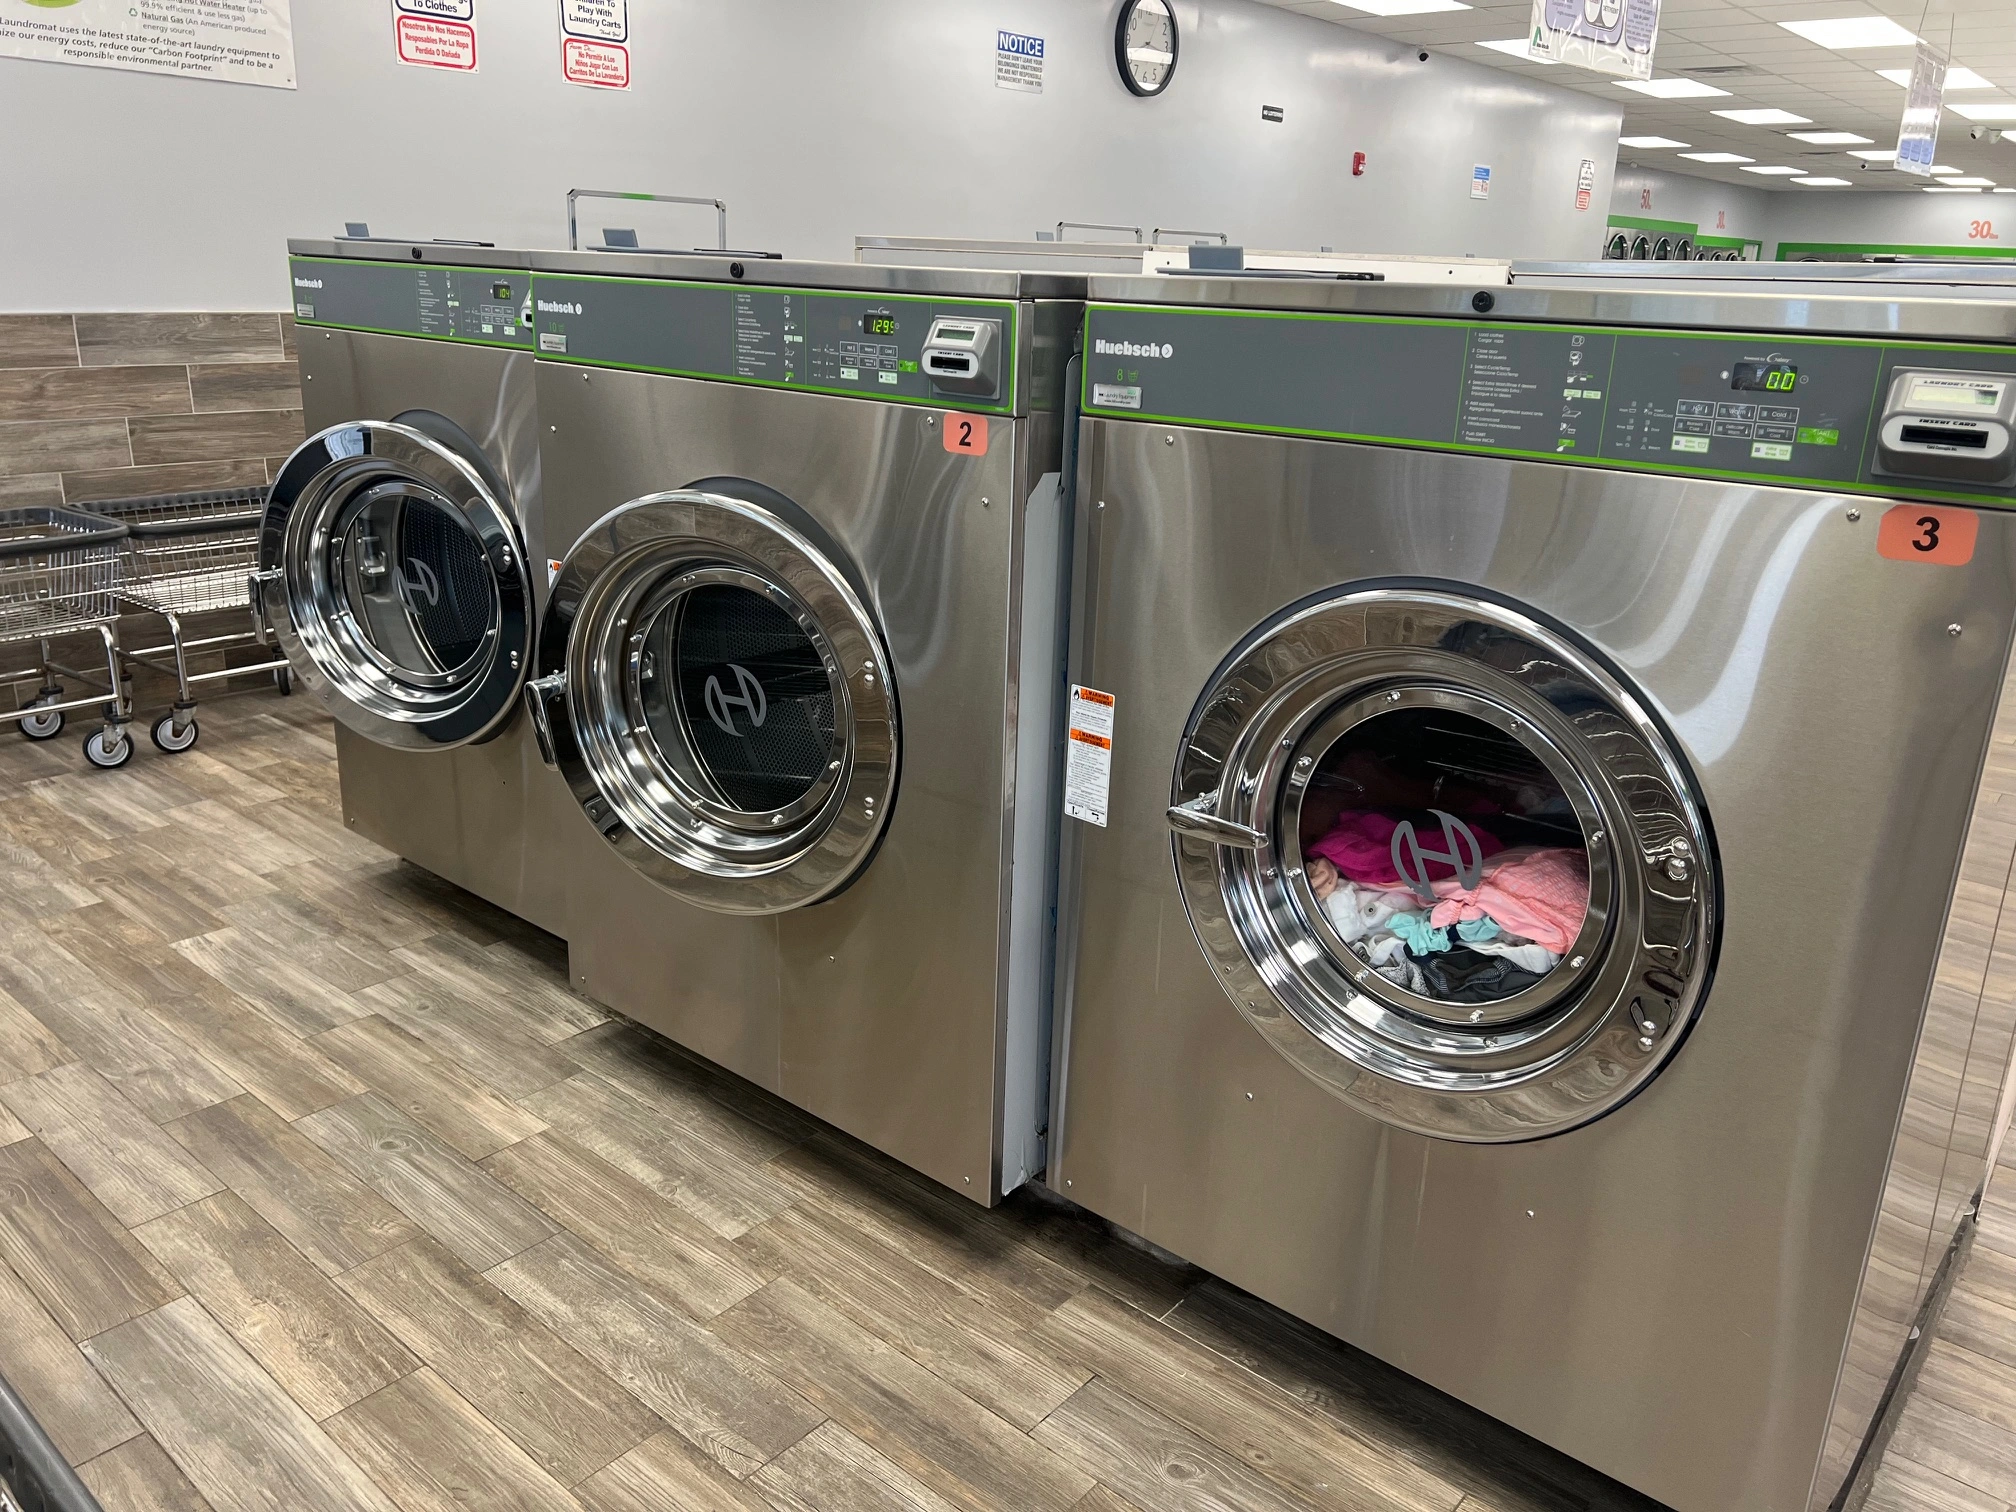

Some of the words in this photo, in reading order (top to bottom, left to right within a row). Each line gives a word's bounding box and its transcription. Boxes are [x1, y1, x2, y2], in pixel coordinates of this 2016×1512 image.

[200, 0, 220, 8] Water
[222, 2, 245, 11] Heater
[247, 5, 258, 13] (up
[425, 0, 458, 13] Clothes
[577, 4, 594, 16] Play
[594, 7, 612, 17] With
[607, 0, 616, 8] To
[141, 1, 163, 10] 99.9%
[165, 5, 195, 14] efficient
[217, 10, 230, 19] less
[231, 14, 245, 22] gas)
[141, 12, 168, 21] Natural
[170, 16, 183, 24] Gas
[185, 18, 198, 26] (An
[200, 20, 233, 30] American
[234, 25, 267, 35] produced
[569, 13, 600, 27] Laundry
[601, 19, 621, 29] Carts
[142, 24, 168, 33] energy
[170, 27, 195, 36] source)
[427, 24, 434, 32] No
[446, 27, 471, 37] Hacemos
[1162, 22, 1167, 36] 2
[0, 17, 57, 31] Laundromat
[59, 25, 79, 35] uses
[82, 28, 97, 37] the
[99, 30, 123, 40] latest
[126, 33, 192, 49] state-of-the-art
[194, 41, 225, 53] laundry
[226, 47, 270, 60] equipment
[439, 37, 448, 45] Por
[456, 40, 469, 49] Ropa
[1000, 32, 1042, 56] NOTICE
[18, 32, 35, 40] our
[37, 35, 69, 45] energy
[72, 38, 97, 48] costs,
[99, 41, 129, 51] reduce
[131, 45, 146, 53] our
[229, 57, 244, 65] and
[246, 59, 255, 67] to
[256, 60, 267, 68] be
[1164, 40, 1169, 52] 3
[63, 48, 115, 60] responsible
[117, 54, 179, 68] environmental
[181, 61, 213, 72] partner.
[1142, 71, 1148, 83] 6
[1152, 68, 1157, 81] 5
[1968, 220, 1991, 239] 30
[537, 299, 573, 314] Huebsch
[1095, 339, 1160, 358] Huebsch
[1923, 379, 1967, 387] LAUNDRY
[1918, 418, 1951, 426] INSERT
[1952, 420, 1977, 428] CARD
[958, 421, 972, 447] 2
[1912, 516, 1940, 552] 3
